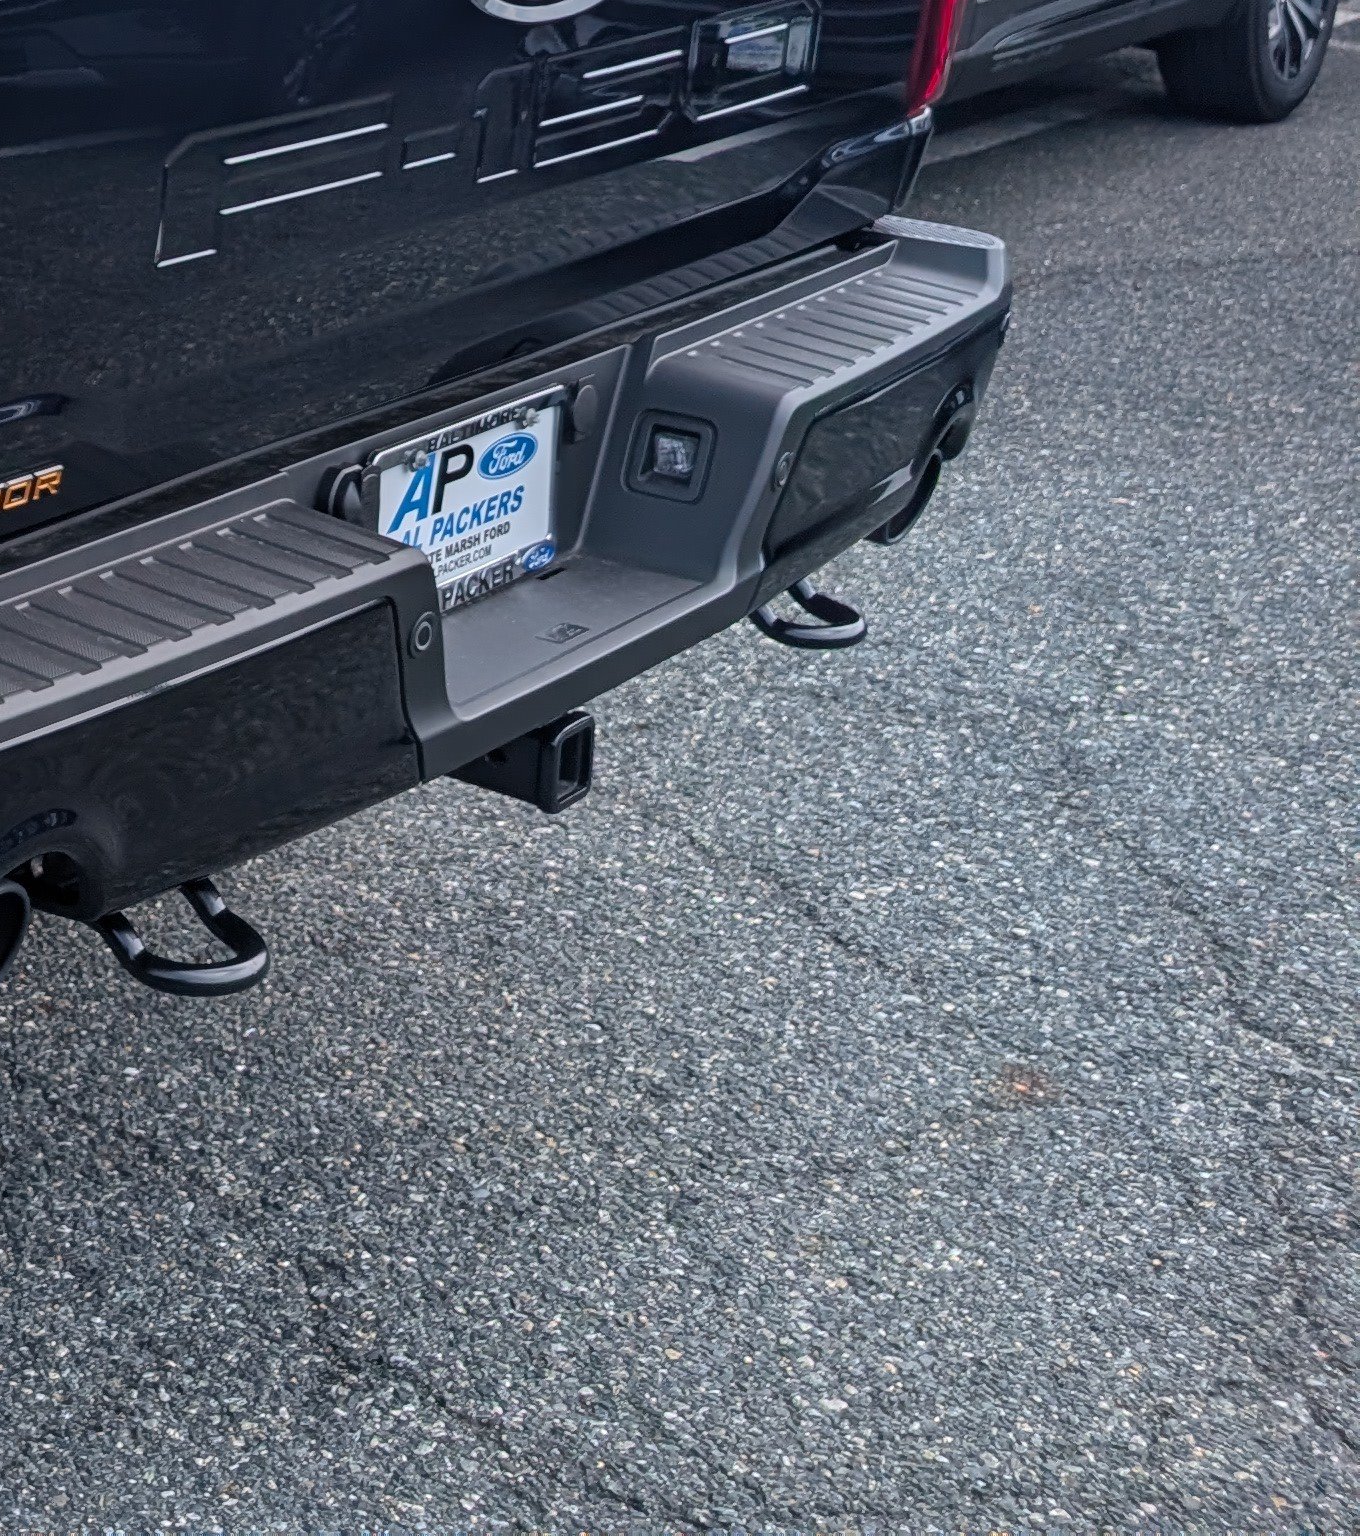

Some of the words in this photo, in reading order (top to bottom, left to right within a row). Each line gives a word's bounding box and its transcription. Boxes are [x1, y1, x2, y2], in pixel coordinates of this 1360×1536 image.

[488, 439, 526, 475] Ford
[429, 485, 525, 546] PACKERS
[445, 533, 481, 558] MARSH
[483, 521, 510, 543] FORD
[440, 562, 514, 610] PACKER
